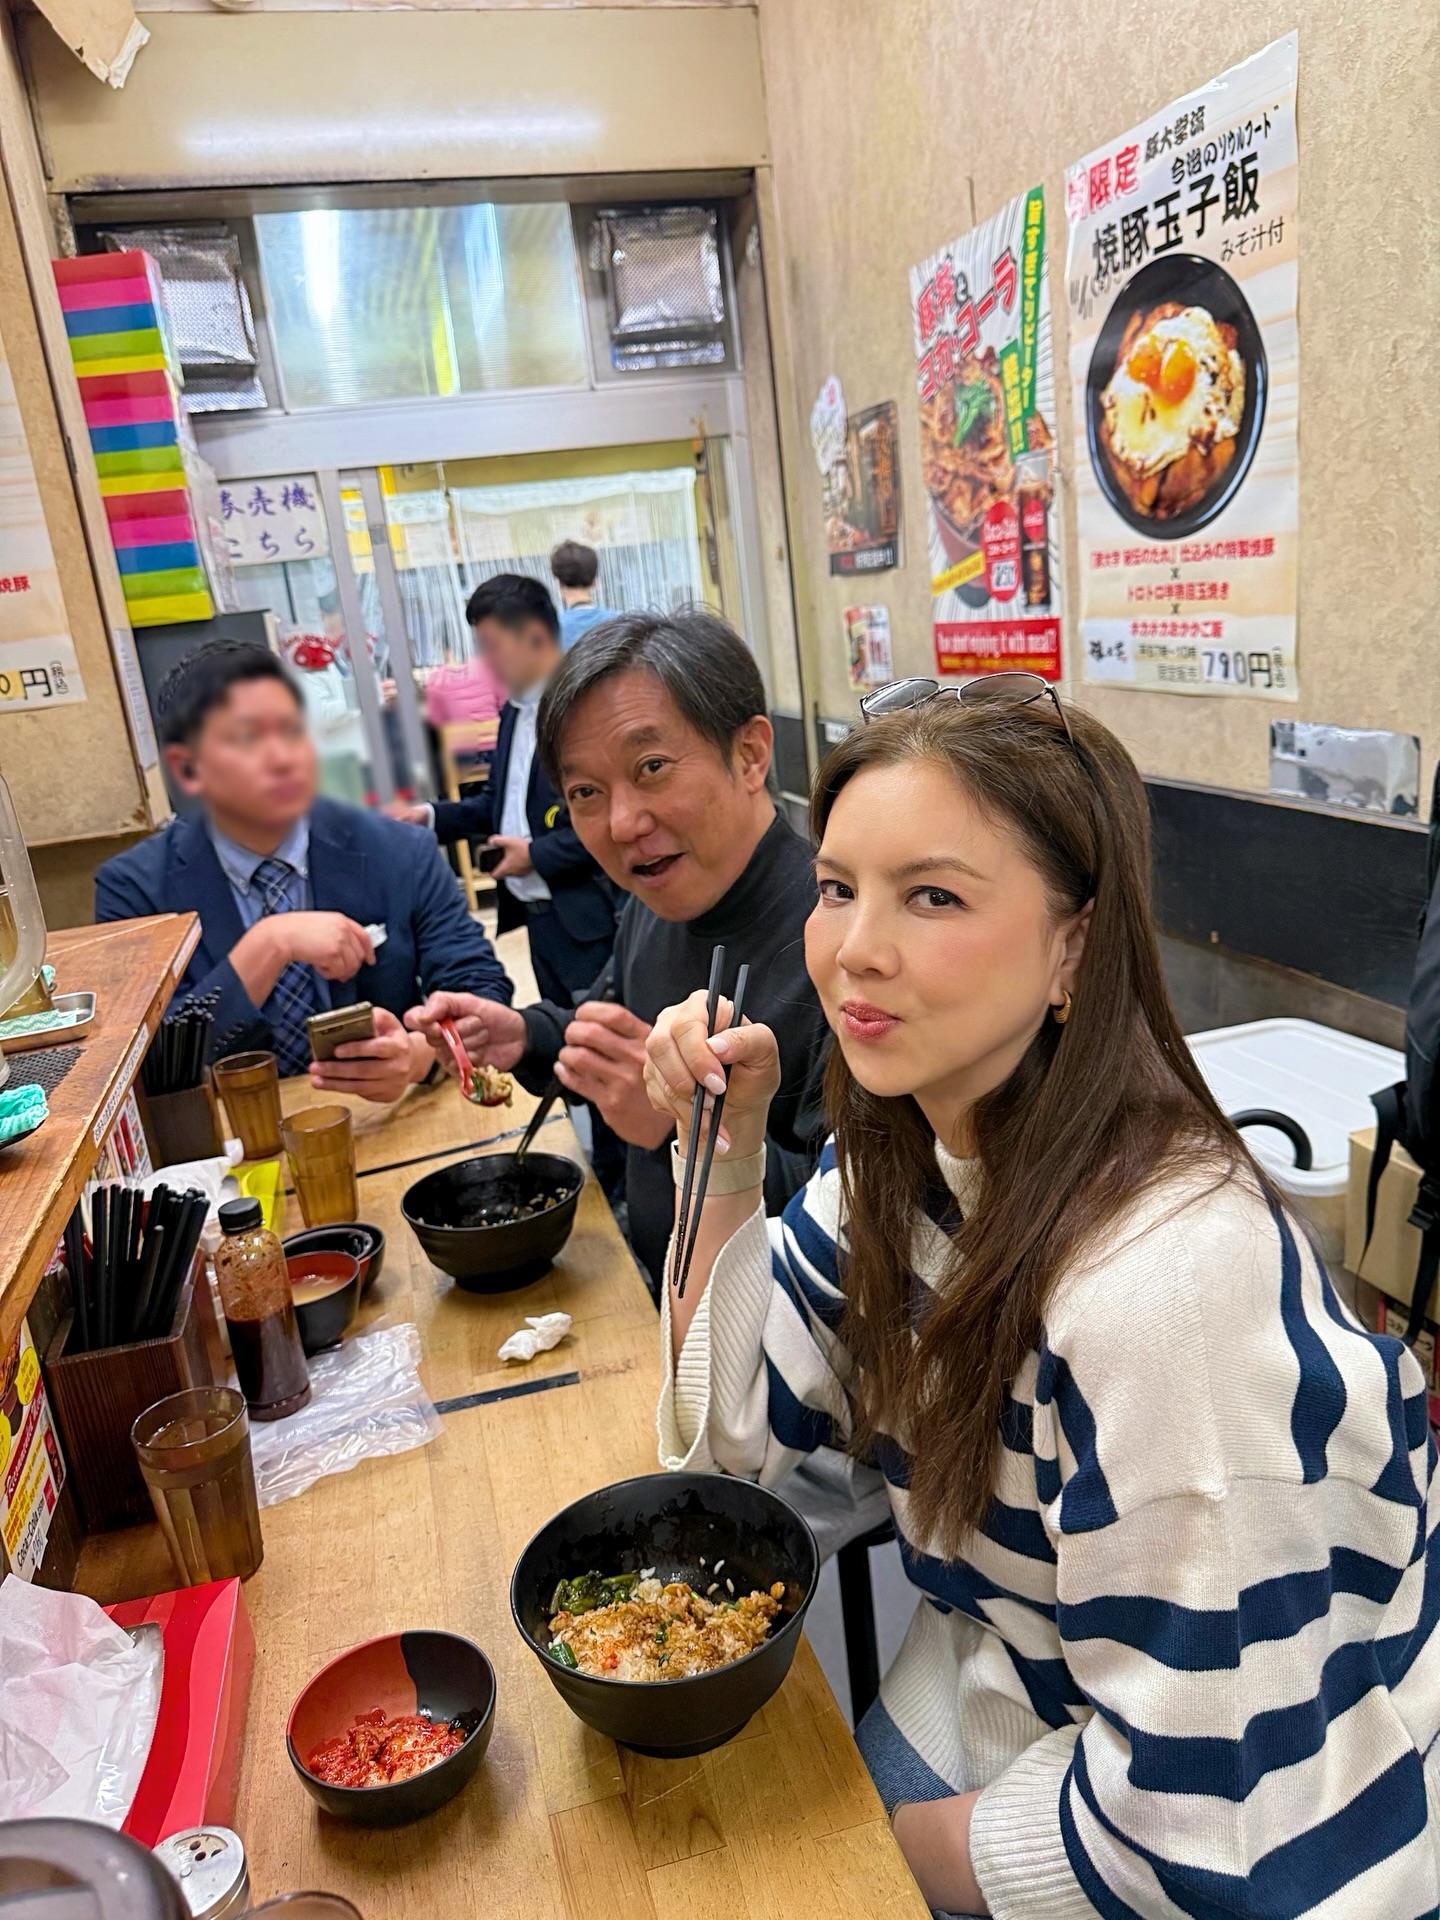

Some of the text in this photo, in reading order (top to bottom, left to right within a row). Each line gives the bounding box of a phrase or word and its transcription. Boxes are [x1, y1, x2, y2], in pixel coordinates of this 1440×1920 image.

[1092, 151, 1260, 279] 焼豚玉子飯
[1220, 216, 1285, 262] みそ汁付
[224, 526, 315, 559] こちら
[1203, 651, 1272, 688] 790円
[17, 1510, 38, 1571] Coca-Cola
